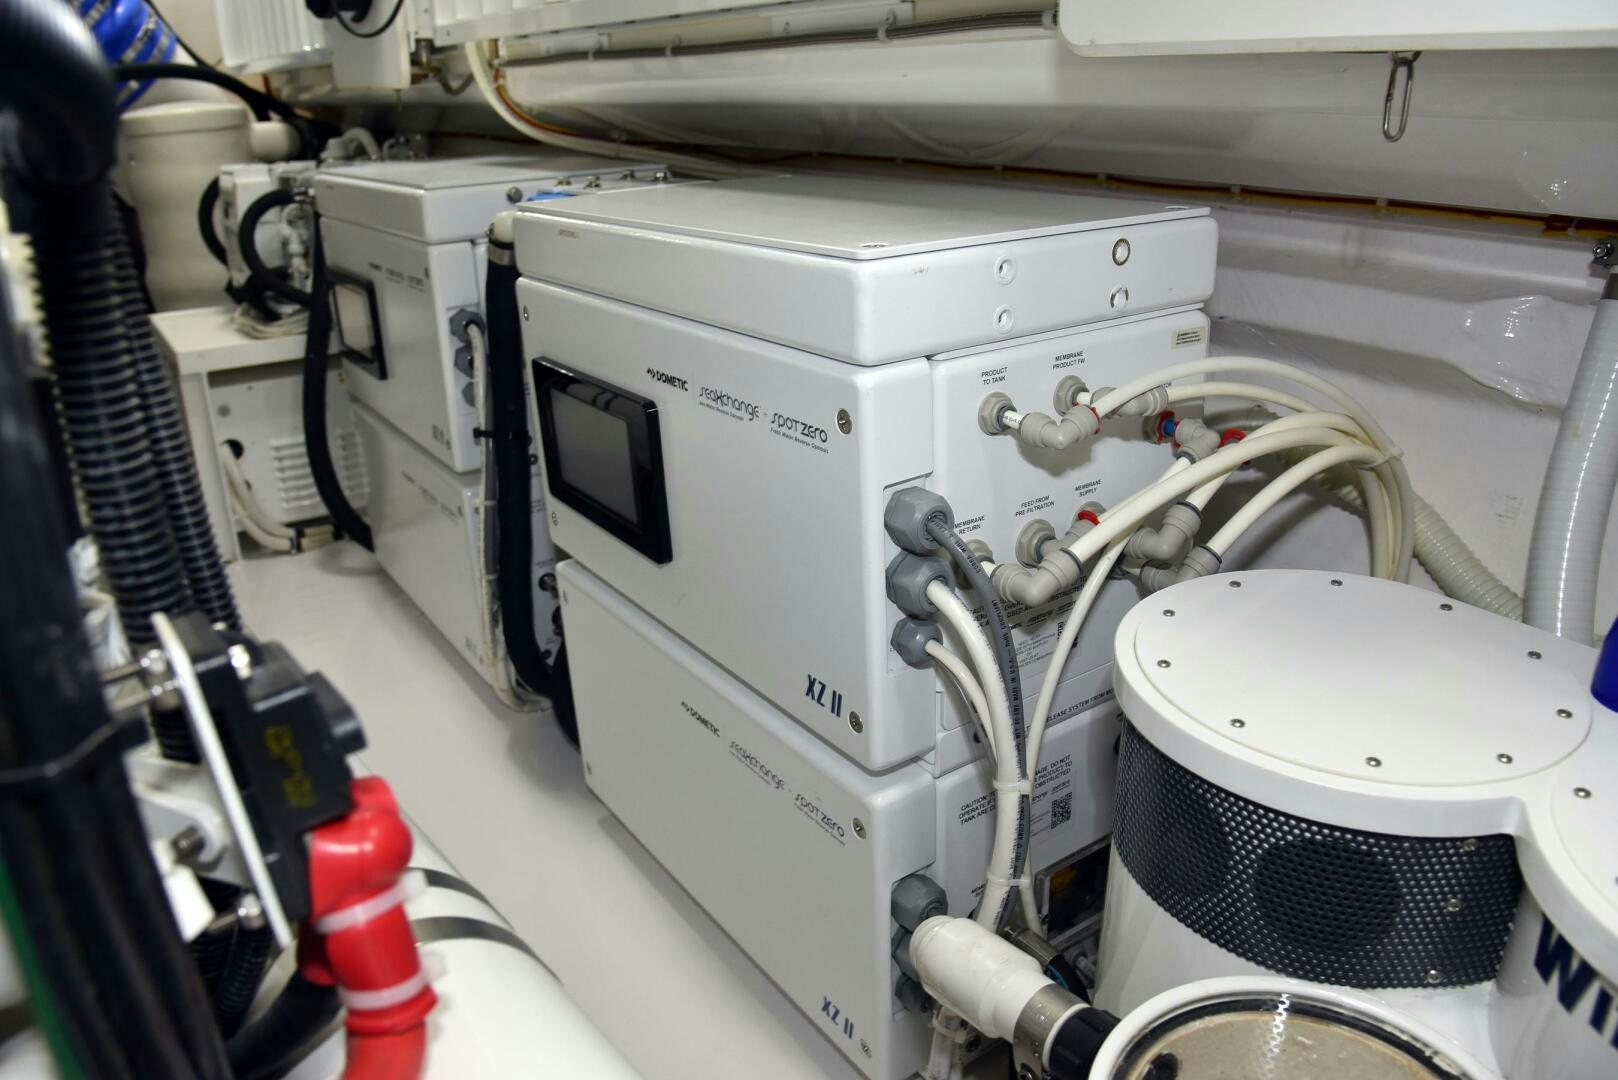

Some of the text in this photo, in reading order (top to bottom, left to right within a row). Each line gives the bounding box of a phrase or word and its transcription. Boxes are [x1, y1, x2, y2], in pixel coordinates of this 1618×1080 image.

[1055, 351, 1084, 362] MEMBRANE
[1053, 359, 1077, 370] PRODUCT
[981, 366, 1008, 378] PRODUCT
[656, 370, 689, 392] DOMETIC
[992, 375, 1006, 384] TANK
[1075, 479, 1102, 492] MEMBRANE
[1079, 488, 1097, 498] SUPPLY
[1020, 495, 1050, 508] FEED FROM
[954, 515, 985, 529] MEMBRANE
[958, 524, 981, 535] RETURN
[805, 673, 843, 718] XZ II
[1050, 754, 1071, 769] DO NOT
[959, 802, 986, 820] OPERATE
[960, 815, 977, 824] TANK
[821, 995, 854, 1039] XZ II
